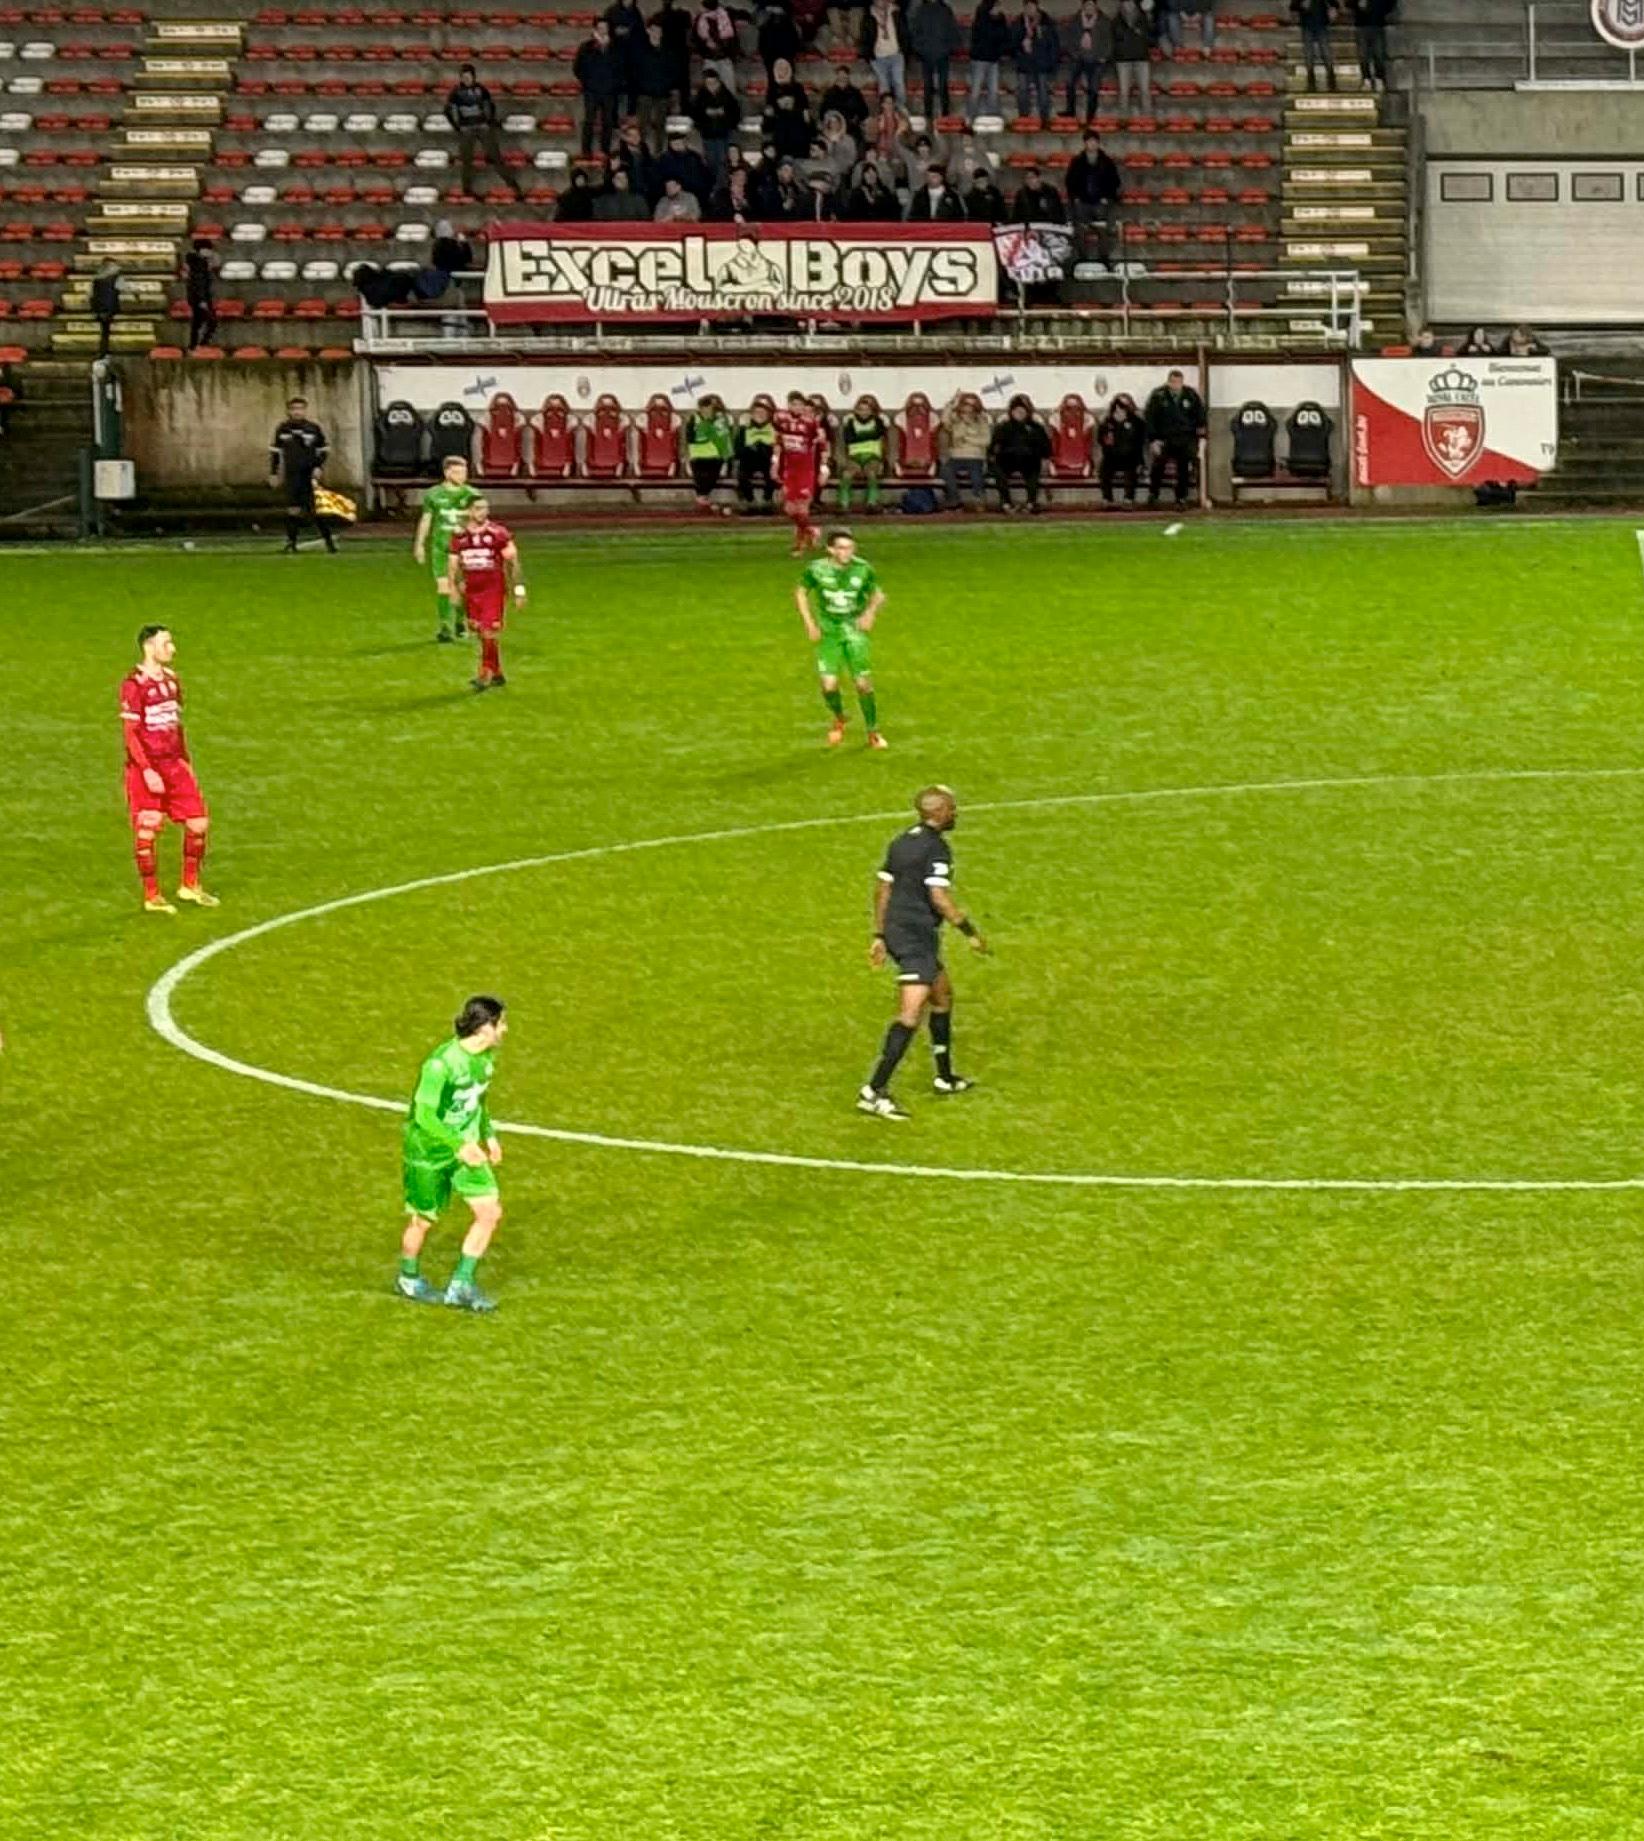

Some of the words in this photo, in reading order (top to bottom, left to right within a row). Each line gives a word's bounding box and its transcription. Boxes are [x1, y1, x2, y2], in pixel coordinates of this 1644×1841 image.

[502, 235, 715, 295] Excel
[789, 238, 977, 306] Boys
[664, 285, 774, 311] Mouscron
[776, 286, 833, 310] since
[834, 285, 894, 311] 2018
